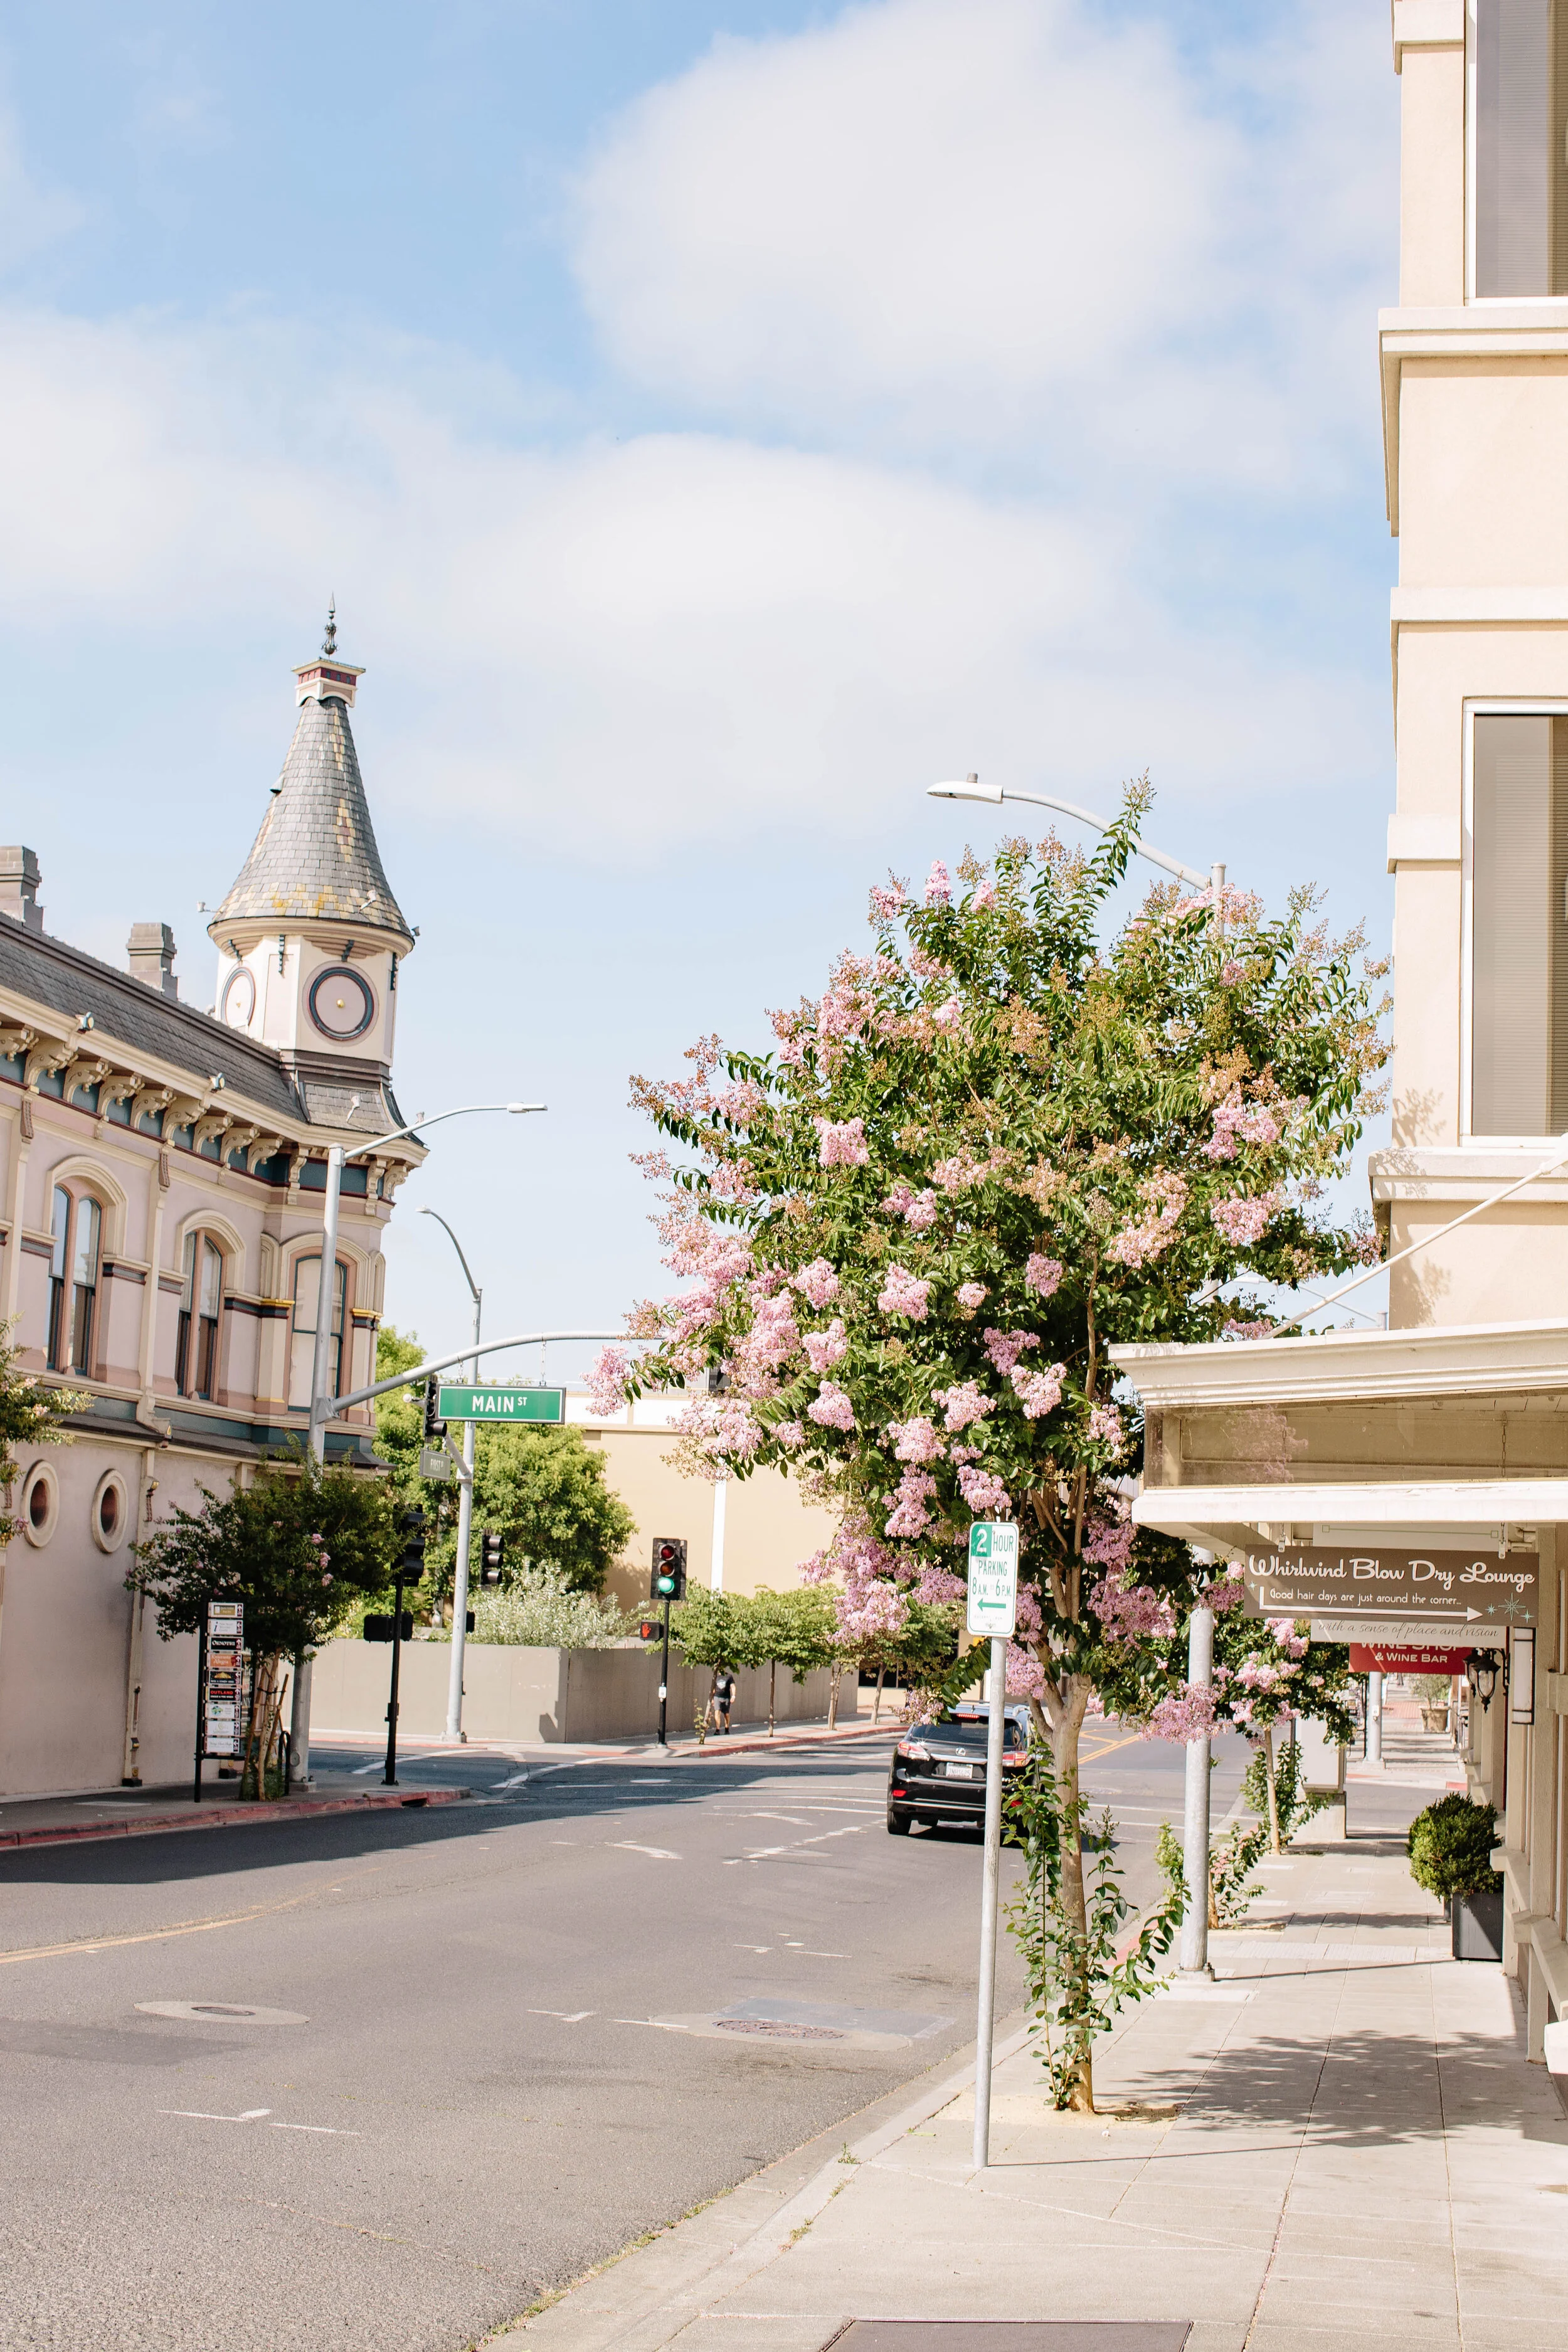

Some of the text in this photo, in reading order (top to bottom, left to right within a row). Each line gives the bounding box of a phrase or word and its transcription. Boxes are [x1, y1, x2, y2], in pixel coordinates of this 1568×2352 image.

[472, 1395, 527, 1413] MAIN ST
[976, 1528, 1014, 1553] 2 HOUR
[978, 1560, 1007, 1576] PARKING
[1249, 1554, 1535, 1593] Whirlwind Blow Dry Lounge
[972, 1577, 1012, 1597] 8 A.M. 6 P.M.
[1270, 1587, 1294, 1600] Good
[1297, 1589, 1315, 1600] hair
[1318, 1589, 1337, 1605] days
[1358, 1593, 1373, 1606] just
[1376, 1592, 1408, 1604] around
[1412, 1592, 1426, 1604] the
[1318, 1620, 1345, 1631] with
[1359, 1624, 1389, 1633] sense
[1392, 1622, 1406, 1639] of
[1404, 1622, 1438, 1640] place
[1440, 1624, 1468, 1638] and
[1465, 1627, 1499, 1637] vision
[1375, 1651, 1448, 1663] & WINE BAR
